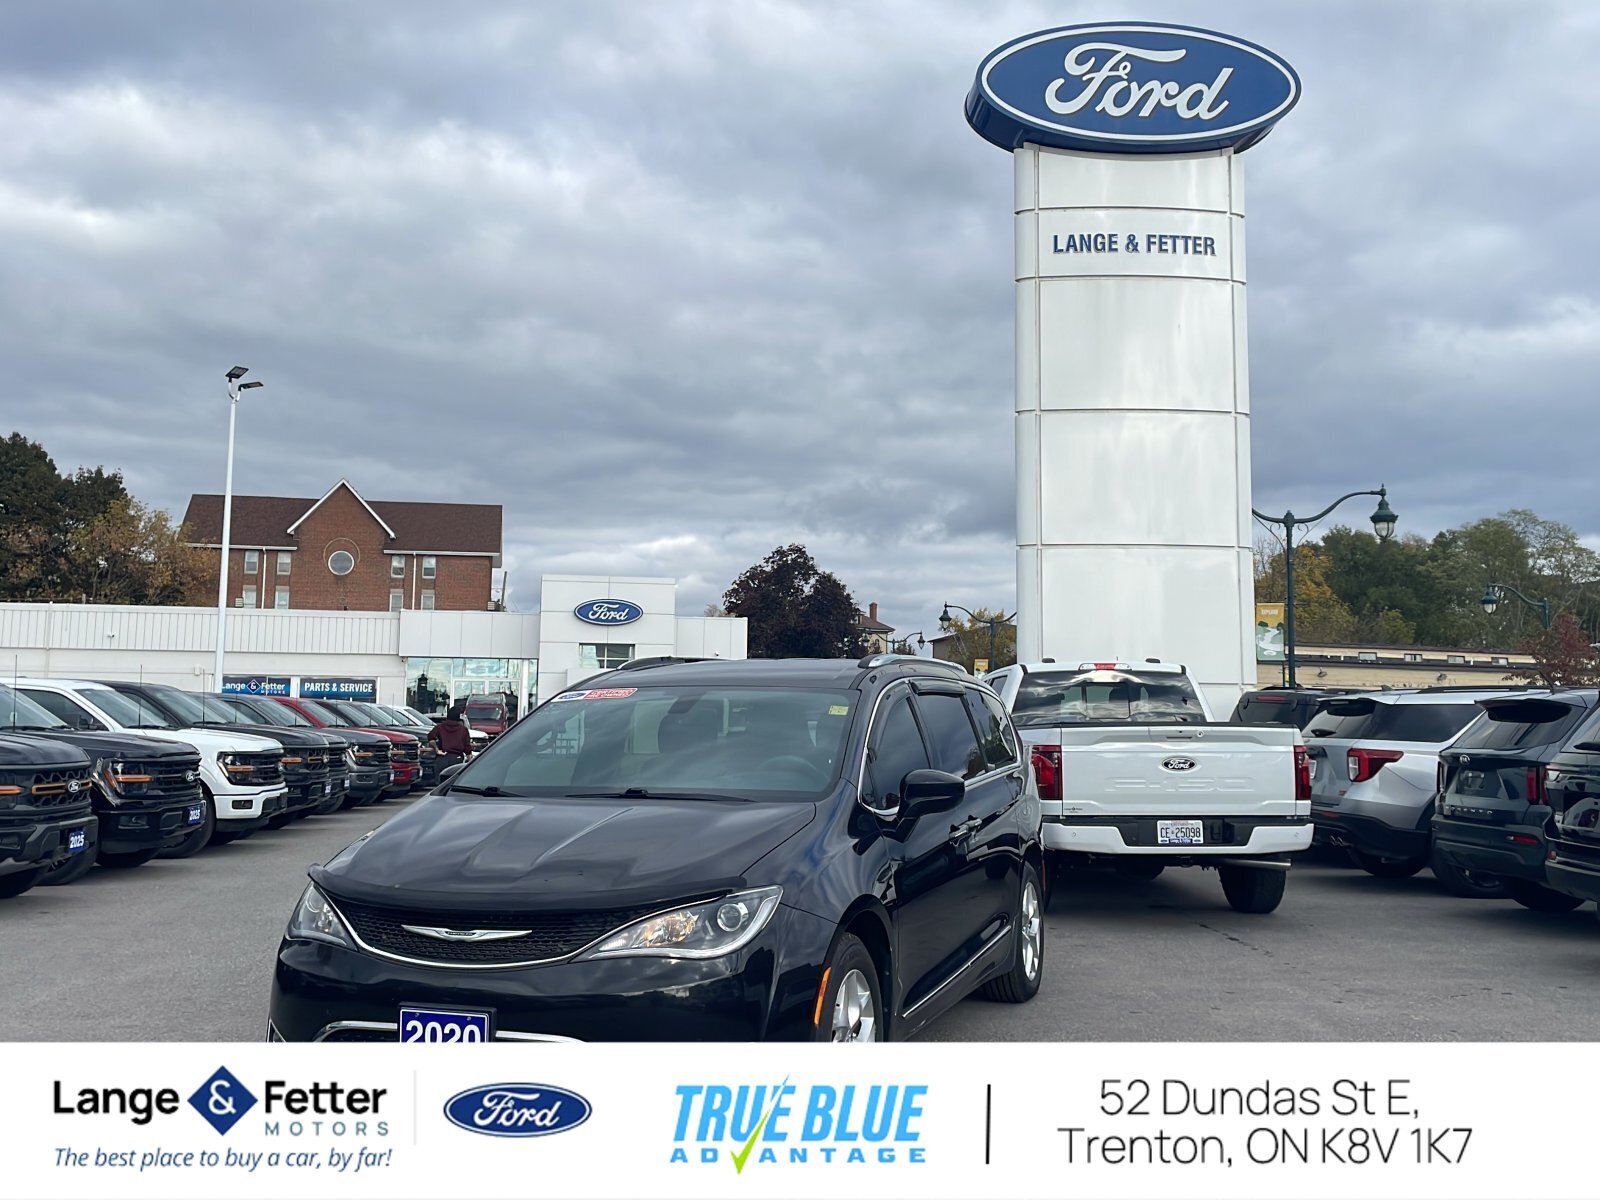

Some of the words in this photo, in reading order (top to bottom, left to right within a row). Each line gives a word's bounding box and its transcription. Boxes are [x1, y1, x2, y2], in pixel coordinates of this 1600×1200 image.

[1044, 42, 1234, 120] Ford
[1053, 233, 1118, 255] LANGE
[1126, 234, 1140, 253] &
[1146, 234, 1217, 257] FETTER
[588, 603, 629, 620] Ford
[222, 682, 246, 691] ange
[260, 683, 286, 691] Fetter
[304, 682, 330, 692] PARTS
[332, 682, 338, 692] &
[339, 683, 373, 693] SERVICE
[1167, 757, 1192, 769] Ford
[189, 808, 201, 821] 2025
[69, 835, 85, 849] 2025
[405, 1020, 482, 1042] 2020
